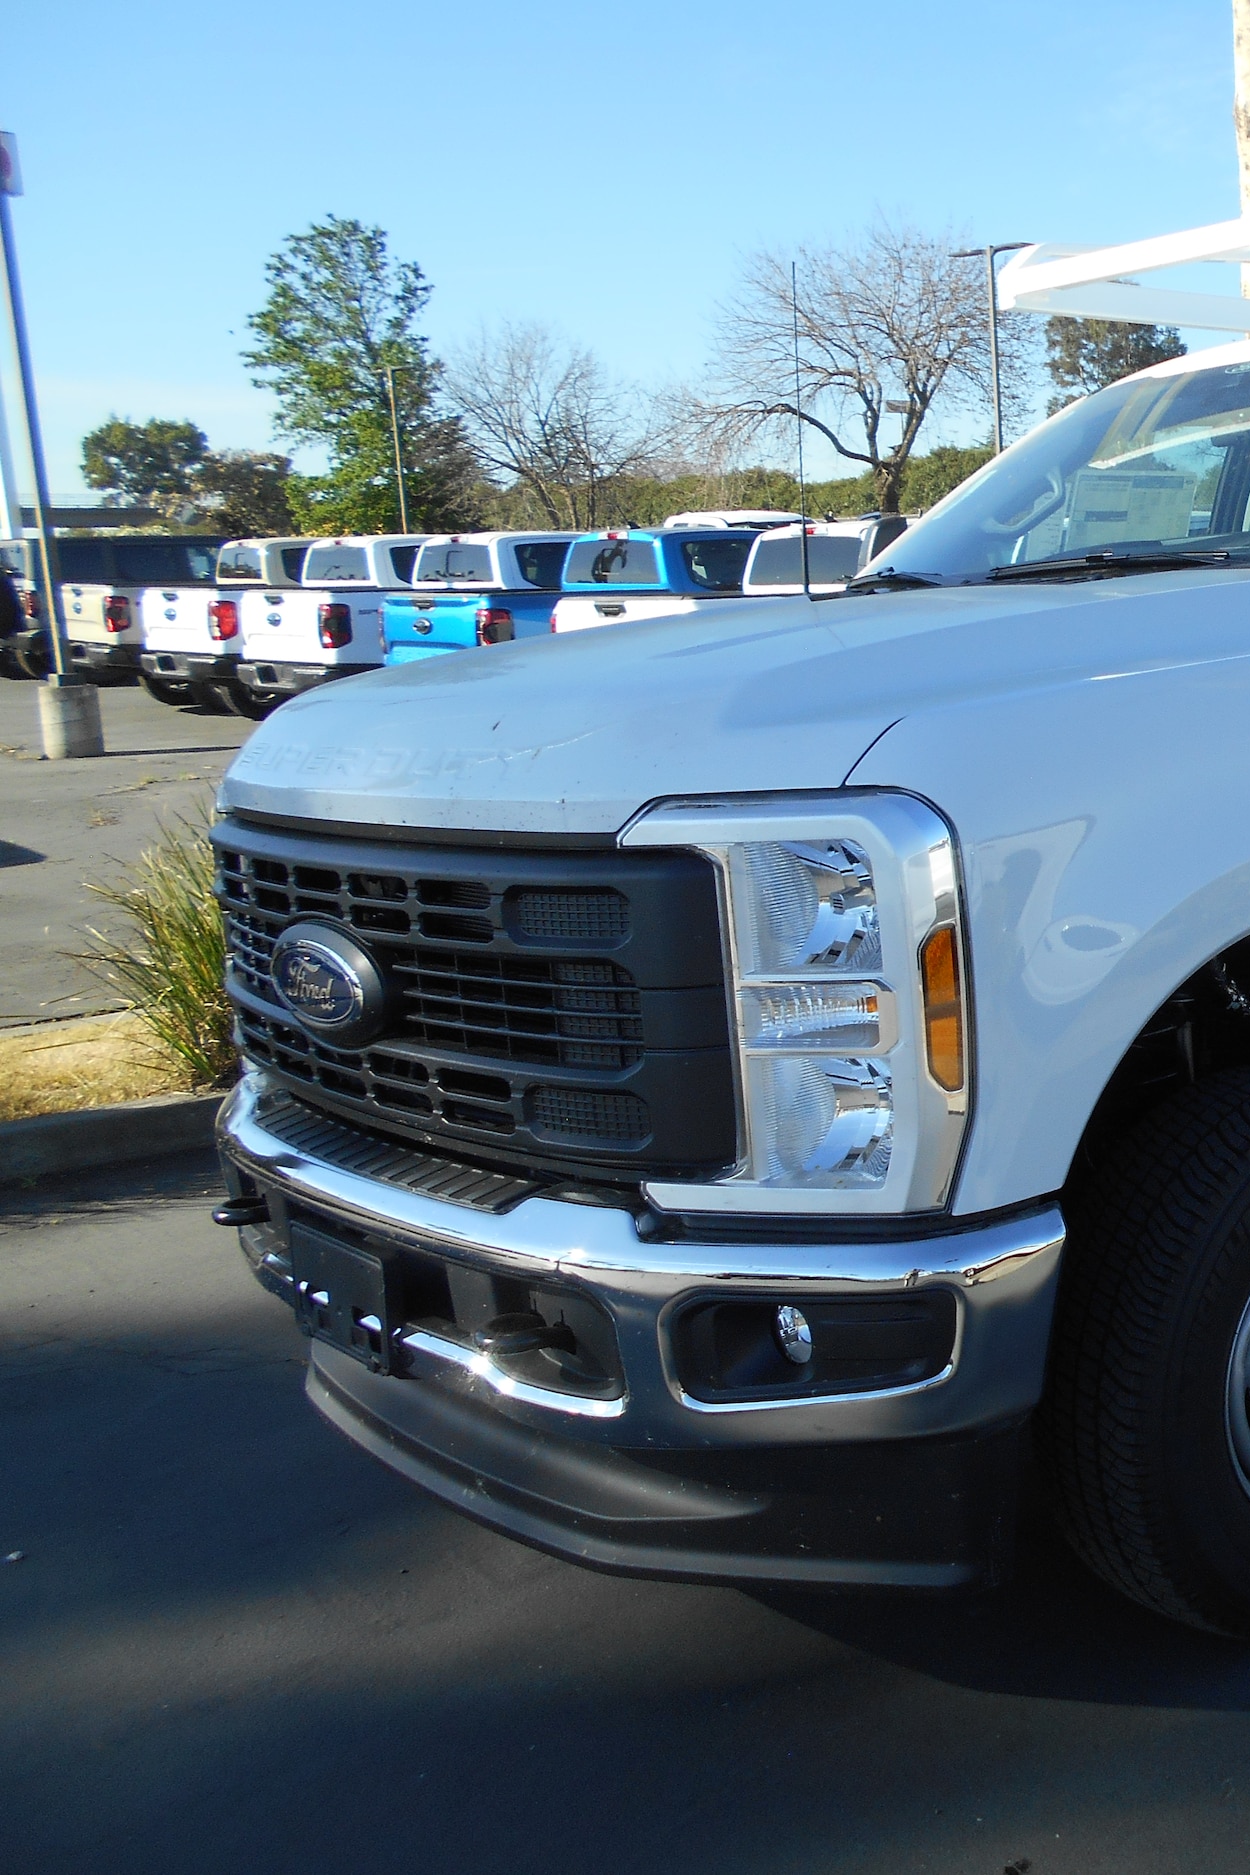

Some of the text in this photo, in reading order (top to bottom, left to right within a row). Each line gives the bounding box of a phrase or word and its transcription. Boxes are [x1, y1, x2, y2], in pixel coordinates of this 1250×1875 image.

[238, 742, 542, 781] SUPER DUTY
[286, 956, 337, 1001] Ford
